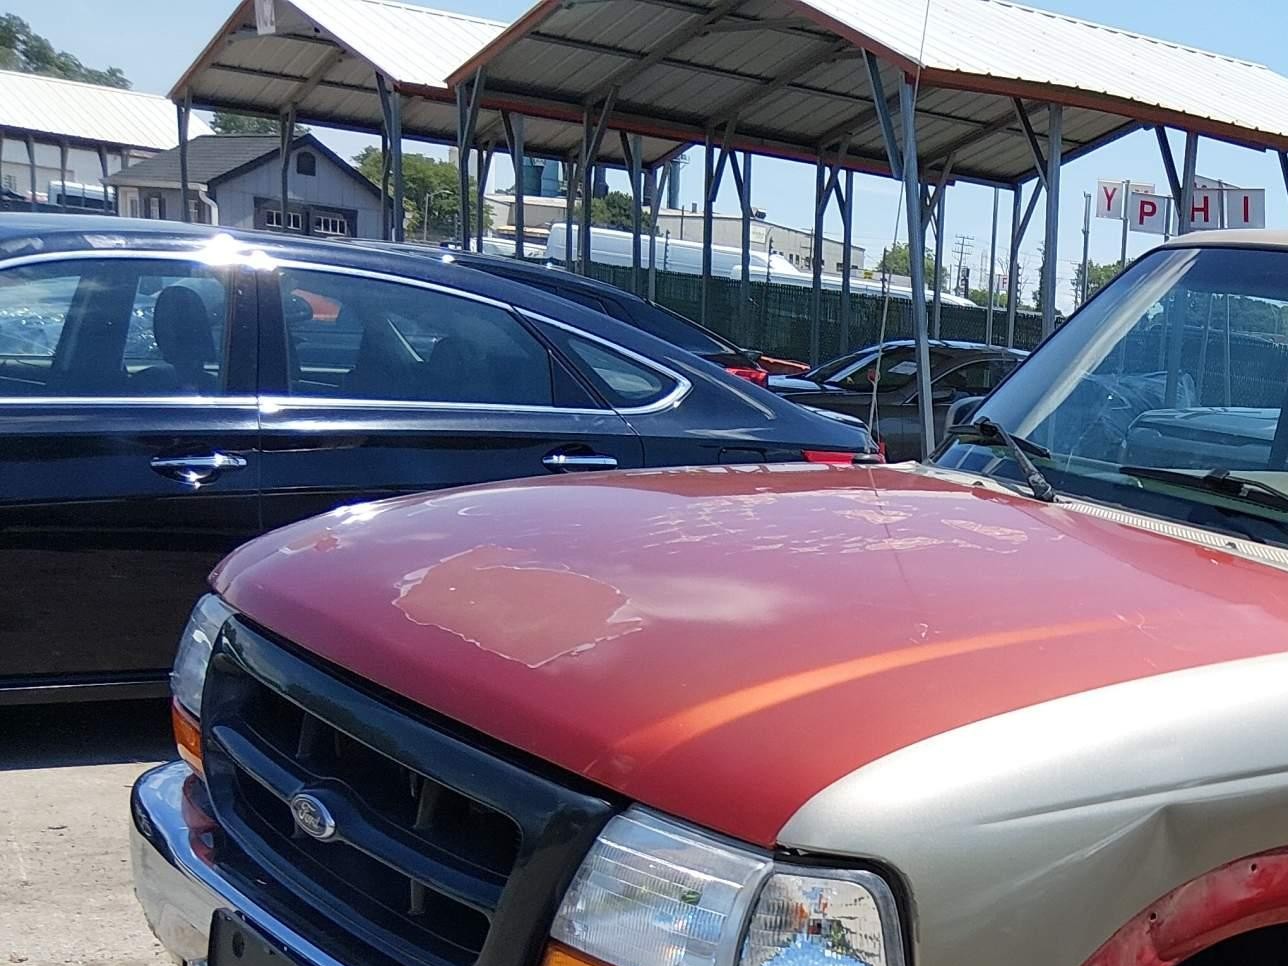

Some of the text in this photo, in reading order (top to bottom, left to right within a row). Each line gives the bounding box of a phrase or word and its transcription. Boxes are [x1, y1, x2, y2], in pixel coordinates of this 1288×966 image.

[1103, 186, 1117, 211] Y
[1190, 196, 1209, 222] H
[1139, 200, 1157, 225] P
